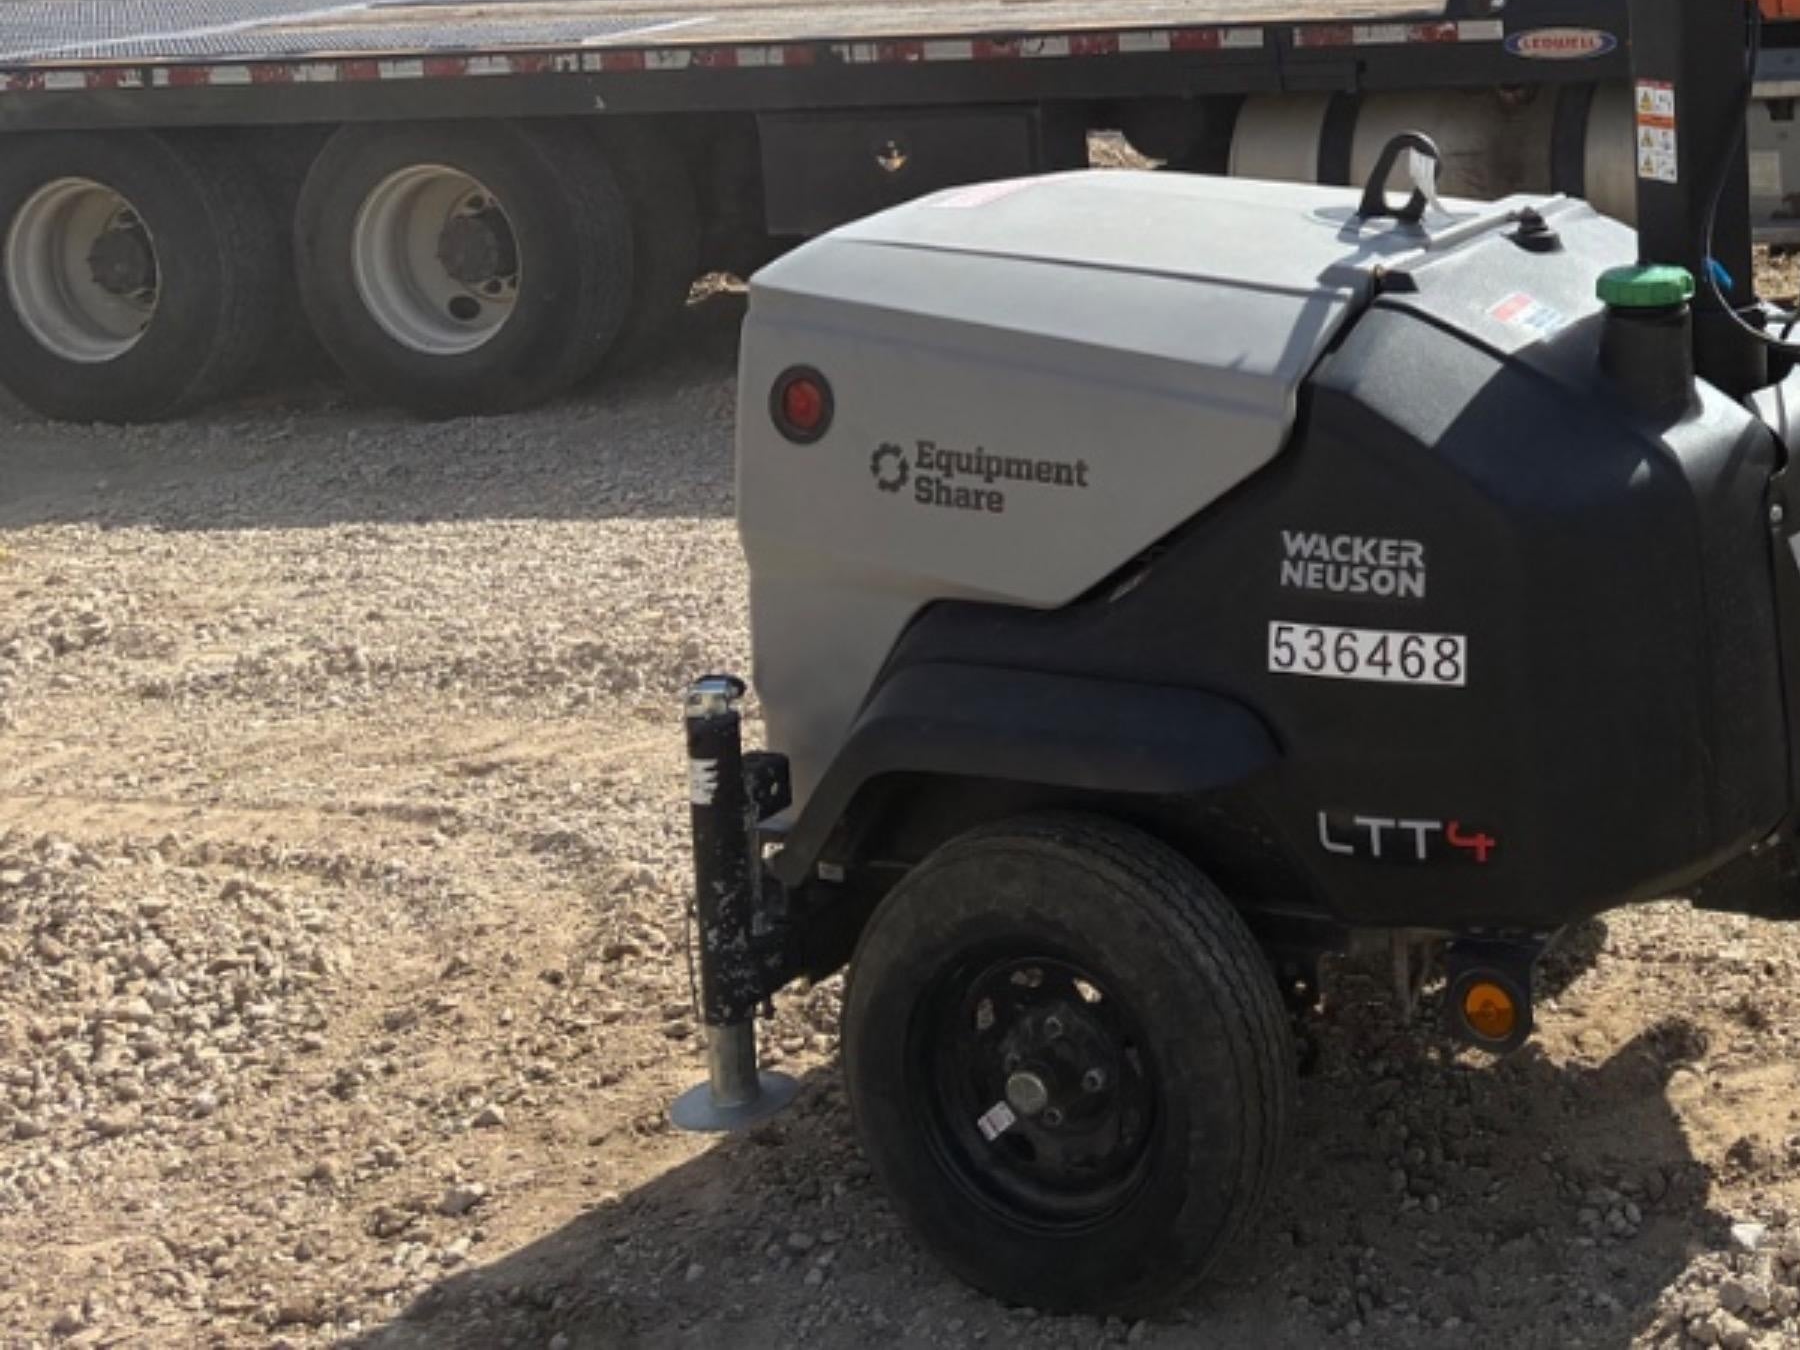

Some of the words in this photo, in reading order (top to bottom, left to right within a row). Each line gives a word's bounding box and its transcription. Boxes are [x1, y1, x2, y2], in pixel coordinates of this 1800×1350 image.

[914, 439, 1089, 487] Equipment
[914, 474, 1005, 514] Share
[1280, 529, 1425, 568] WACKER
[1280, 560, 1426, 598] NEUSON
[1273, 625, 1461, 682] 536468
[1318, 810, 1496, 863] LTT4
